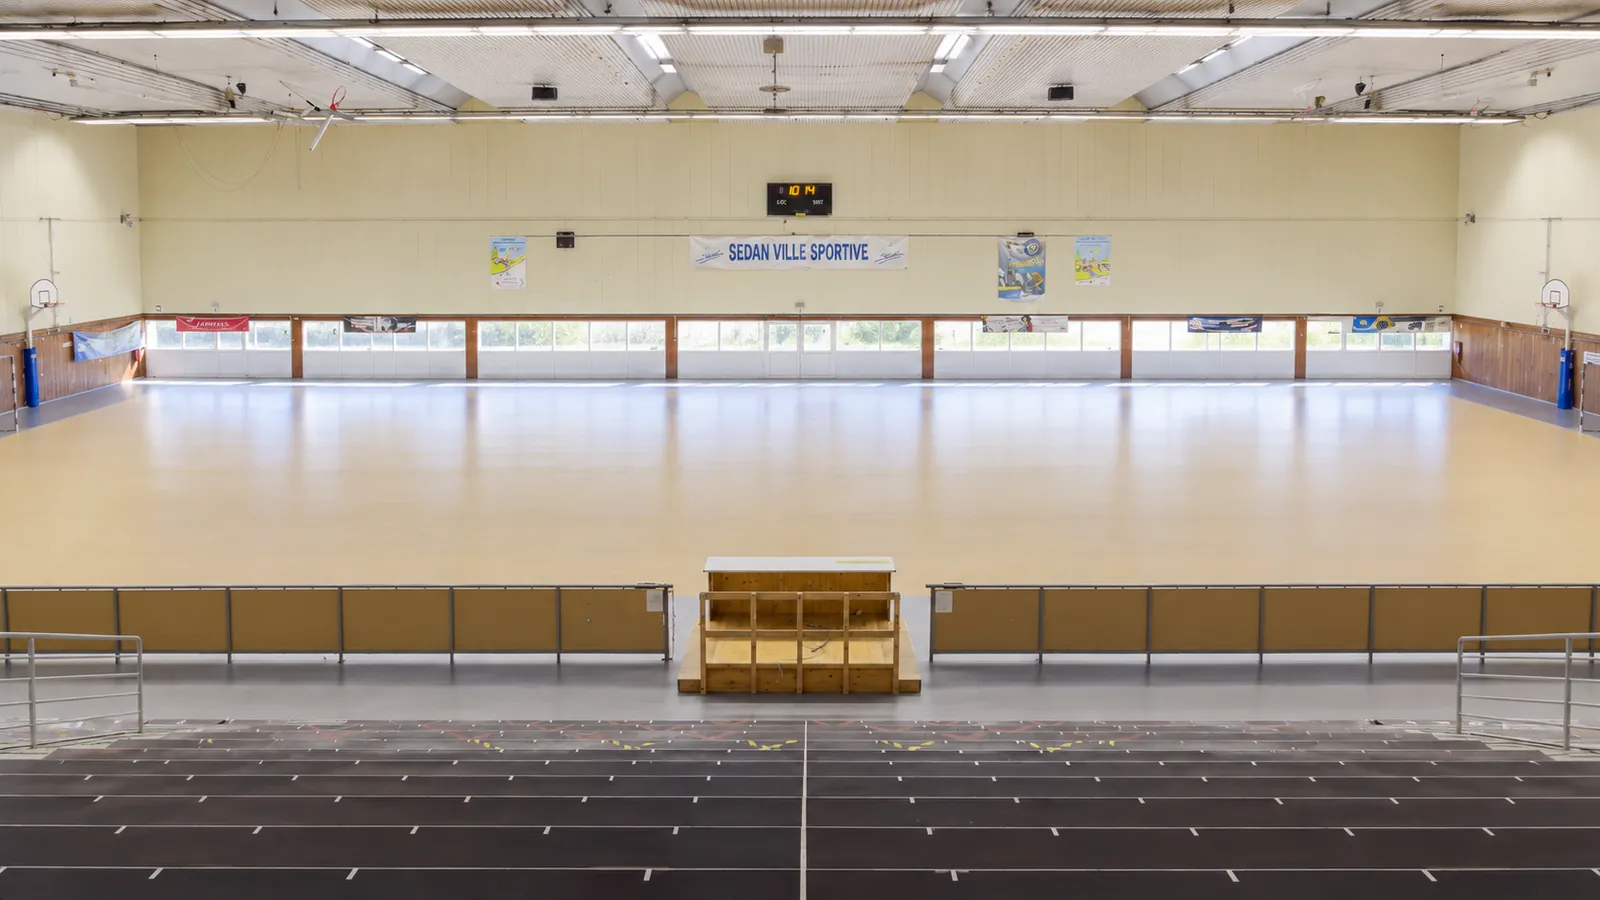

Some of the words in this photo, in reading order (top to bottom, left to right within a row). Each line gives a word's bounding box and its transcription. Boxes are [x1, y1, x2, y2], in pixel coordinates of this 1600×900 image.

[789, 185, 800, 196] 10
[805, 185, 816, 196] 14
[728, 243, 770, 261] SEDAN
[773, 243, 807, 261] VILLE
[810, 243, 869, 261] SPORTIVE
